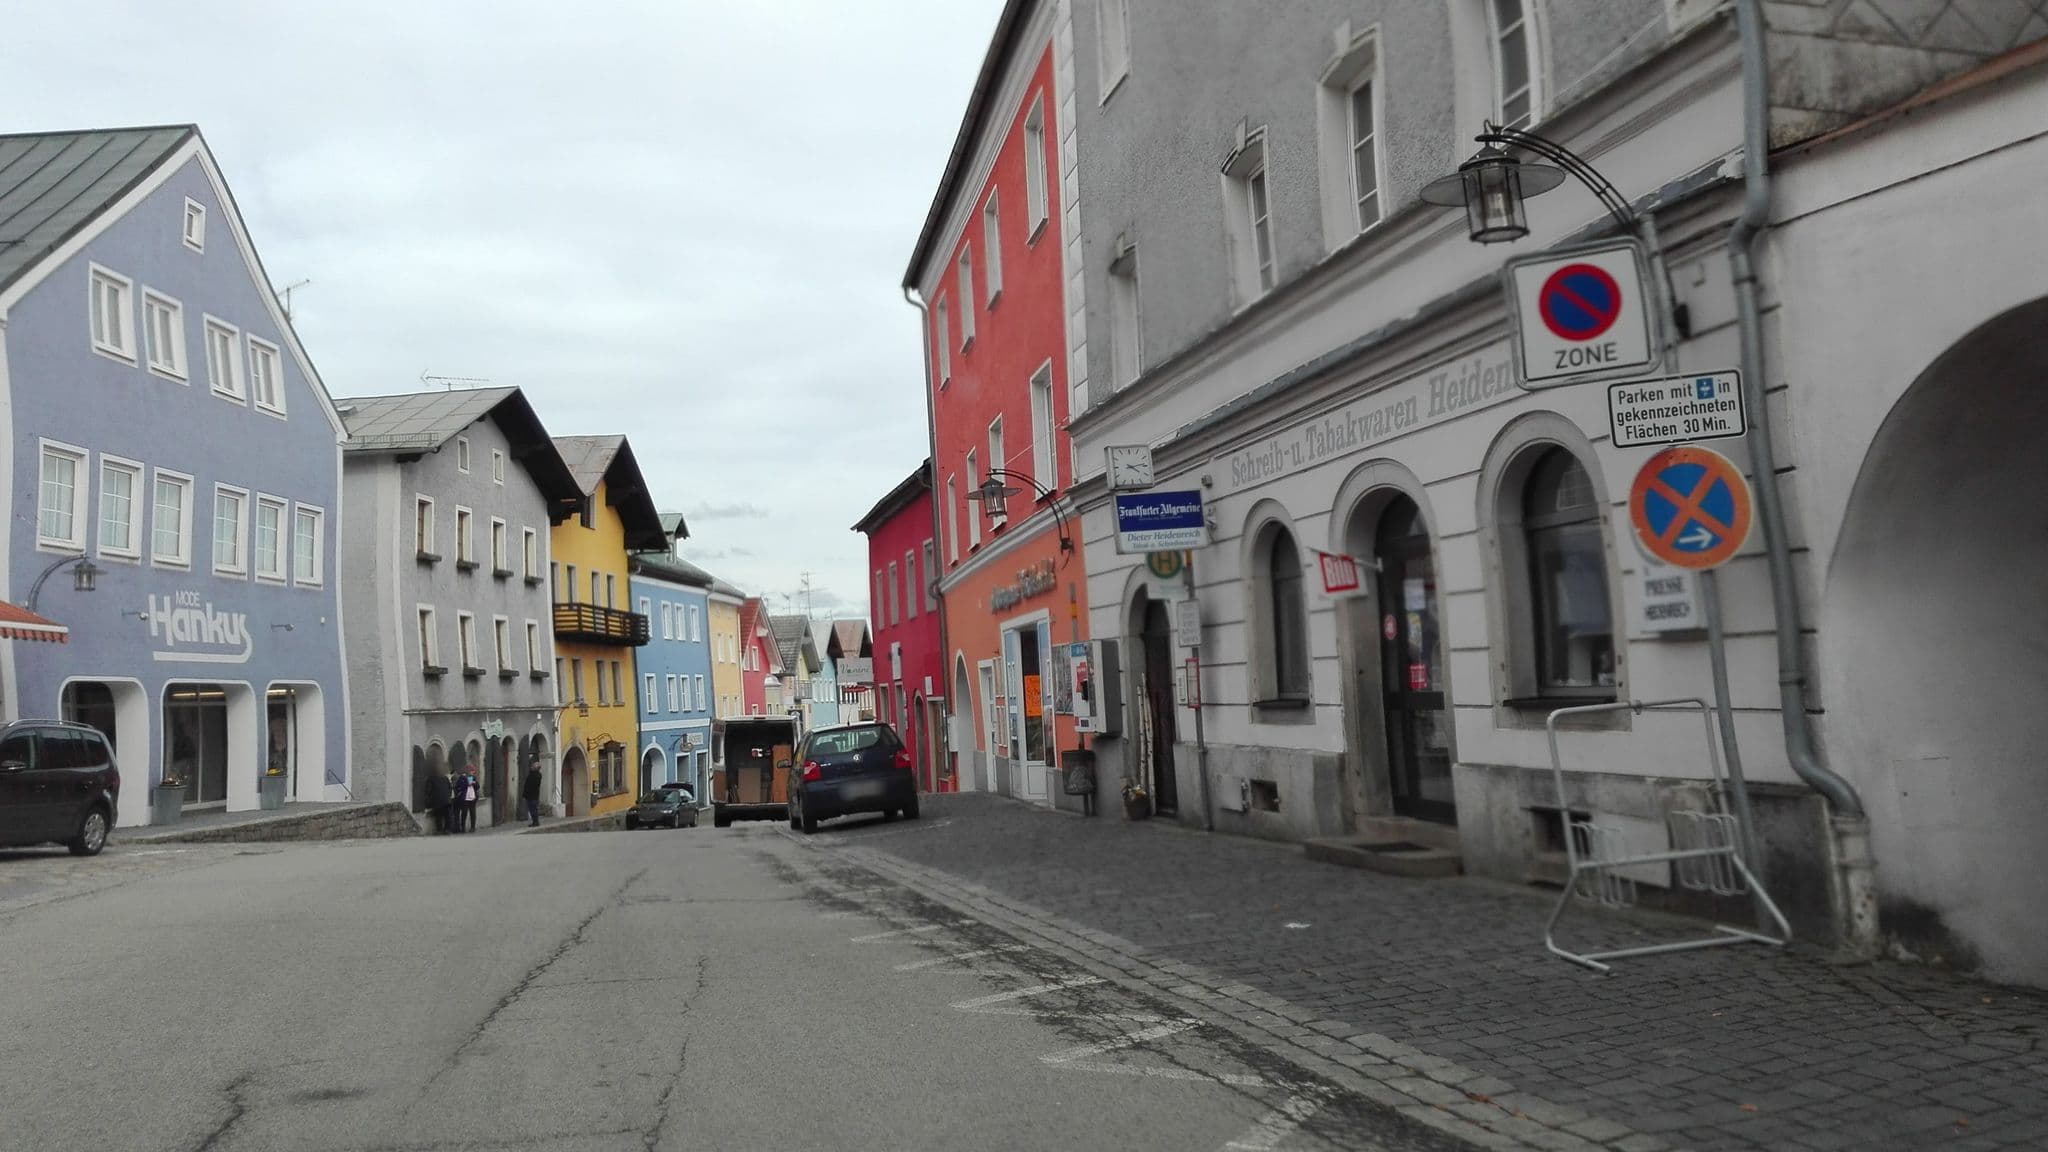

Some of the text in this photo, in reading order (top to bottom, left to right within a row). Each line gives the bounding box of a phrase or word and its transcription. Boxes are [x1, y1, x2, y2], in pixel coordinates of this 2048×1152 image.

[1555, 342, 1618, 369] ZONE
[1618, 379, 1730, 405] Parken mit in
[1306, 394, 1418, 461] Tabakwaren
[1428, 356, 1516, 417] Heiden
[1616, 399, 1736, 426] gekennzeichneten
[1625, 416, 1731, 439] Flächen 30 Min.
[1119, 502, 1201, 520] Frankfurter Allgemeine
[1128, 532, 1152, 542] Dieter
[175, 591, 200, 607] MODE
[148, 593, 253, 664] Hankus
